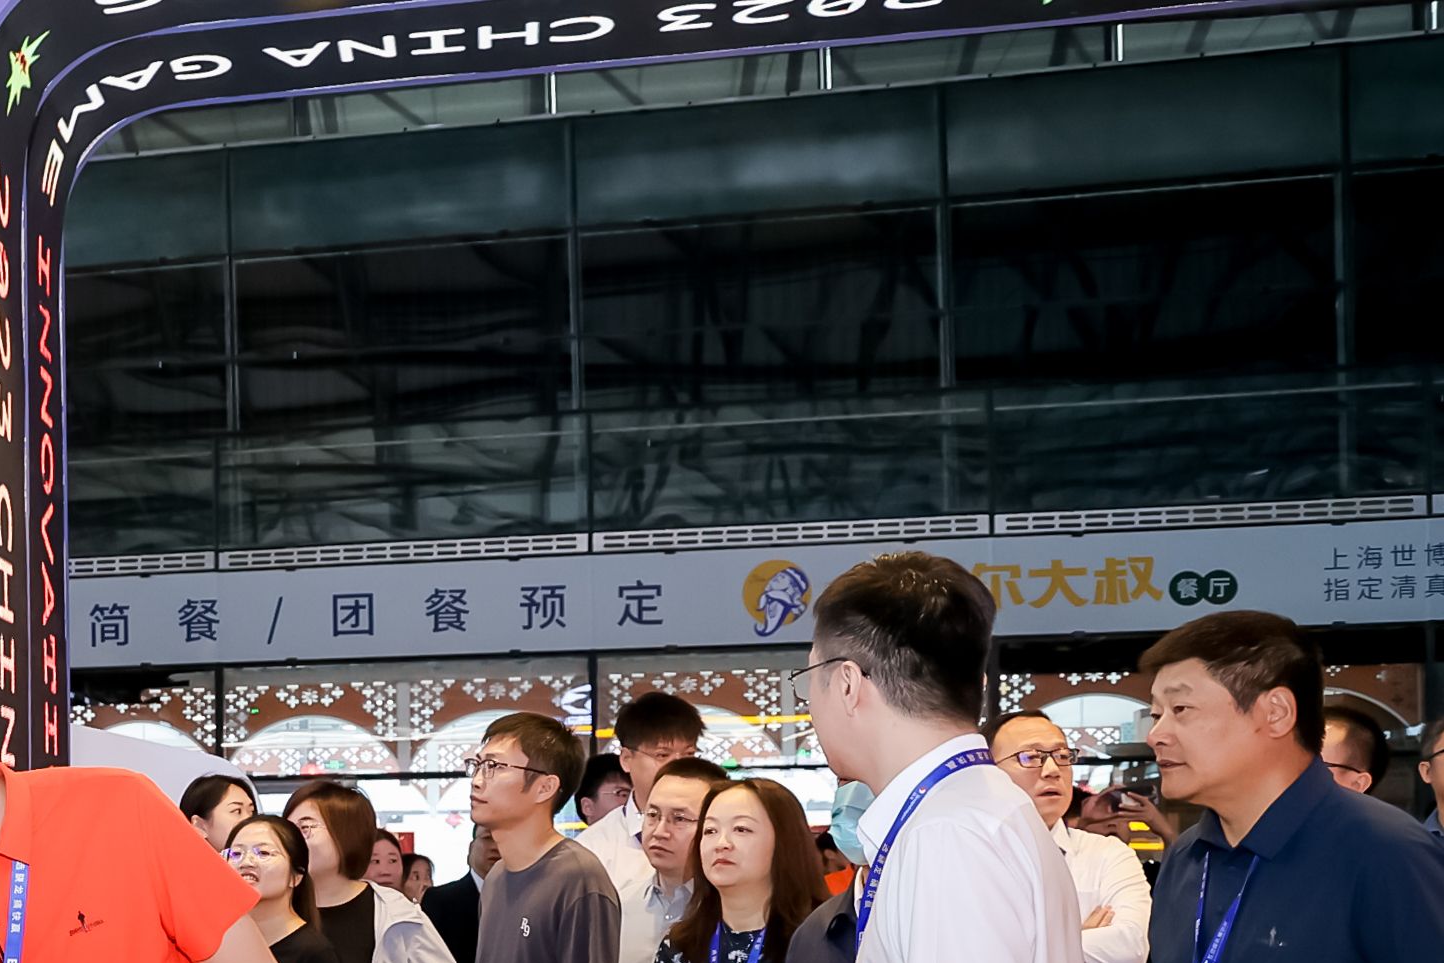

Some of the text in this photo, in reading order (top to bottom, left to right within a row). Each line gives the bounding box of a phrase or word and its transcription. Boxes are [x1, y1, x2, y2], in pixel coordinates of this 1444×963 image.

[262, 15, 616, 68] CHINA
[41, 54, 233, 207] GAME
[37, 235, 59, 757] INNOVATI
[1176, 576, 1231, 599] 餐厅
[1324, 574, 1444, 602] 指定清真
